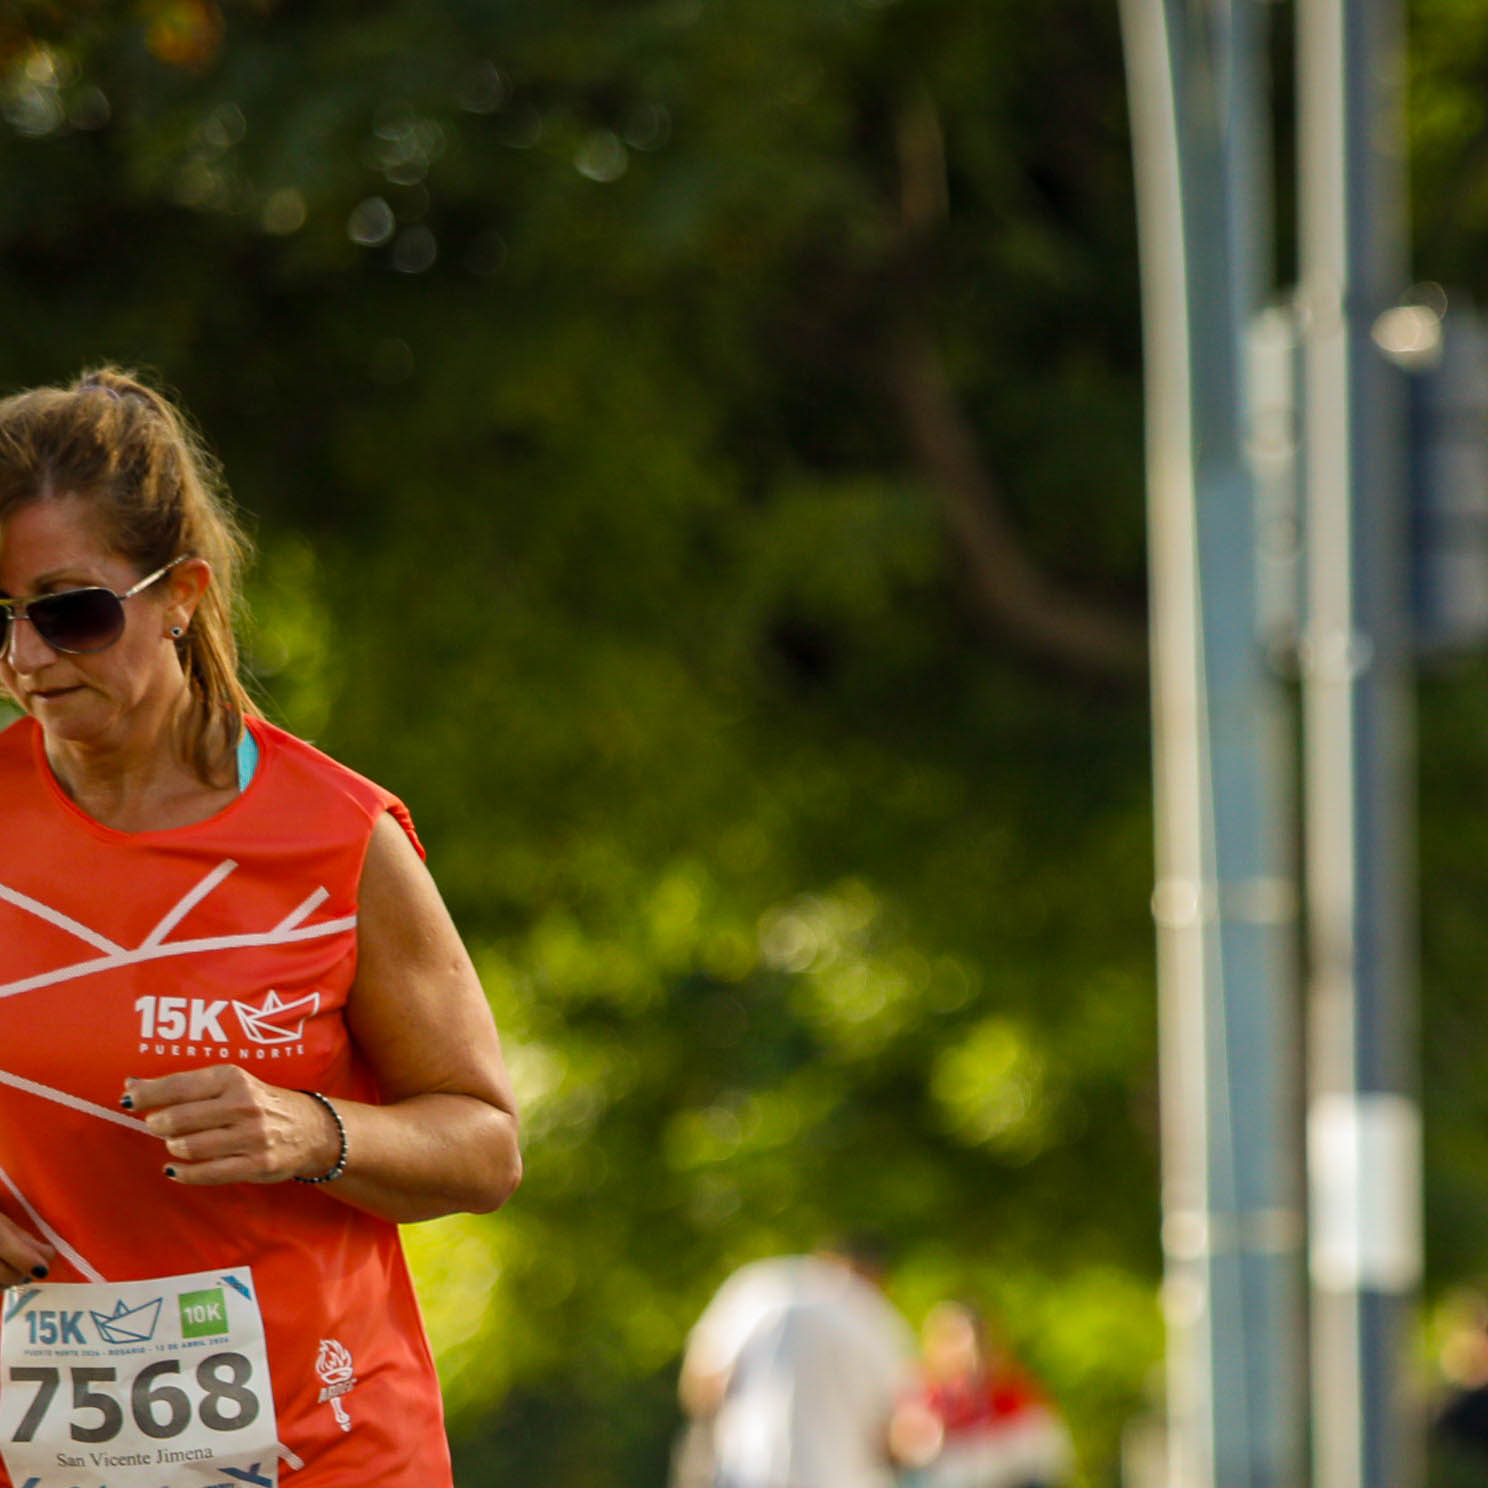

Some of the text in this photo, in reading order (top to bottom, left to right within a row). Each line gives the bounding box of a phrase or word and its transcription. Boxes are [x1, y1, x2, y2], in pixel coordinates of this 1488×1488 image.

[135, 996, 229, 1042] 15K
[139, 1043, 305, 1060] PUERTO NORTE
[25, 1310, 87, 1344] 15K
[184, 1303, 222, 1326] 10K
[10, 1352, 260, 1443] 7568
[56, 1447, 214, 1468] San Vicente Jimena
